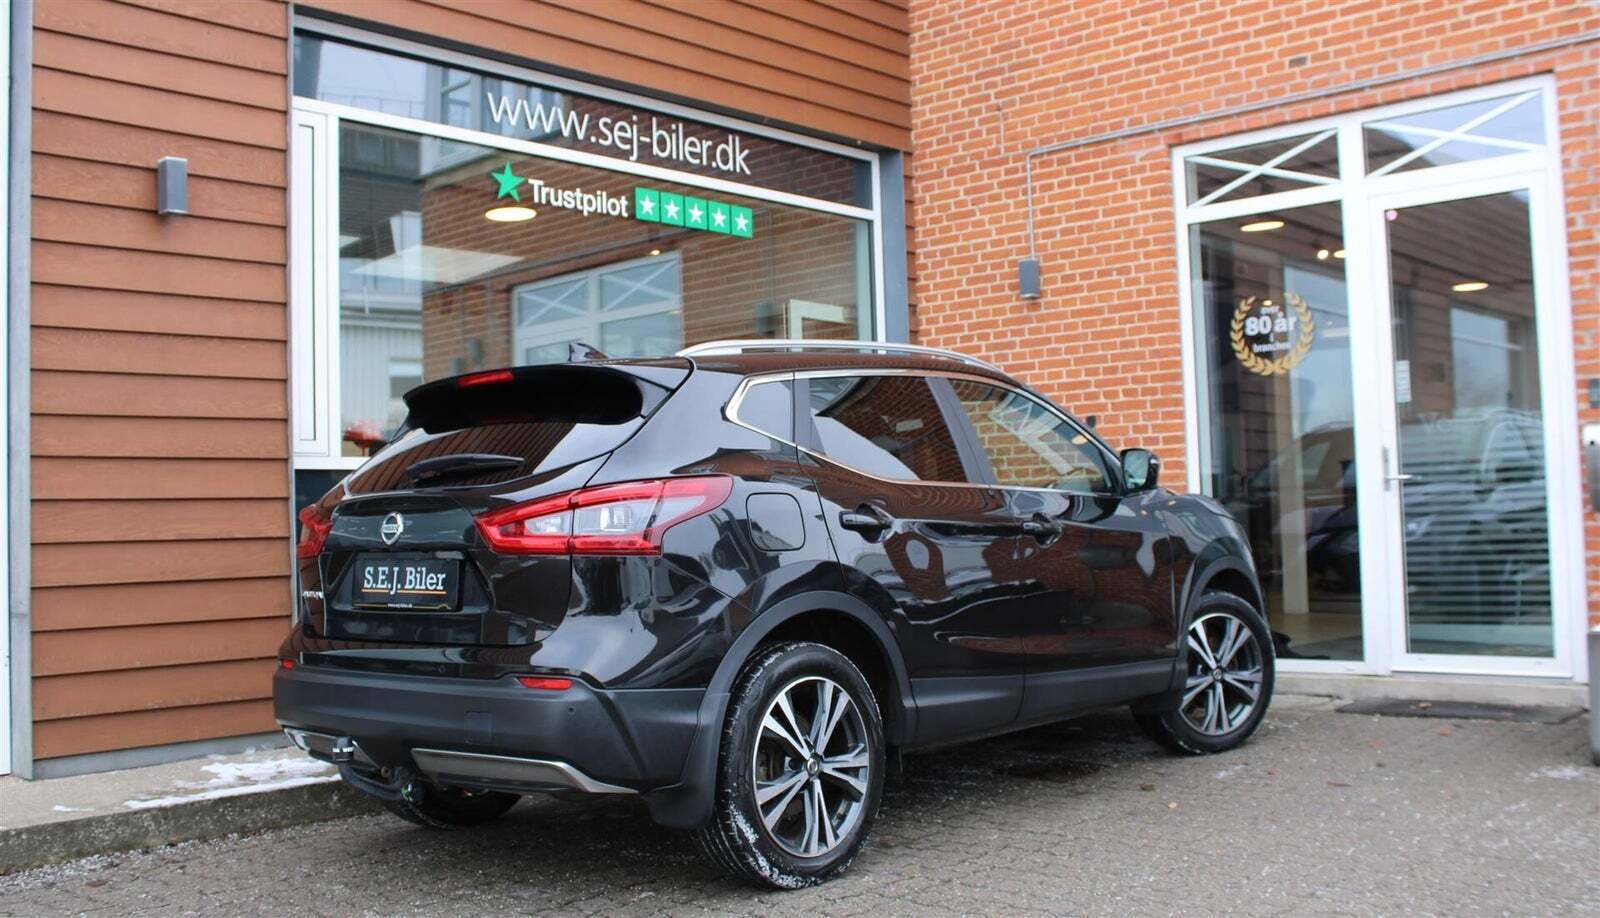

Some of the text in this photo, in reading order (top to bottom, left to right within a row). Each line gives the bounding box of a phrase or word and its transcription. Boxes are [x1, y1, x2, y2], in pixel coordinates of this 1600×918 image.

[487, 92, 751, 174] www.sej-biler.dk
[528, 178, 628, 217] Trustpilot
[1245, 311, 1297, 336] 80 år
[363, 566, 446, 595] S.E.J. Biler
